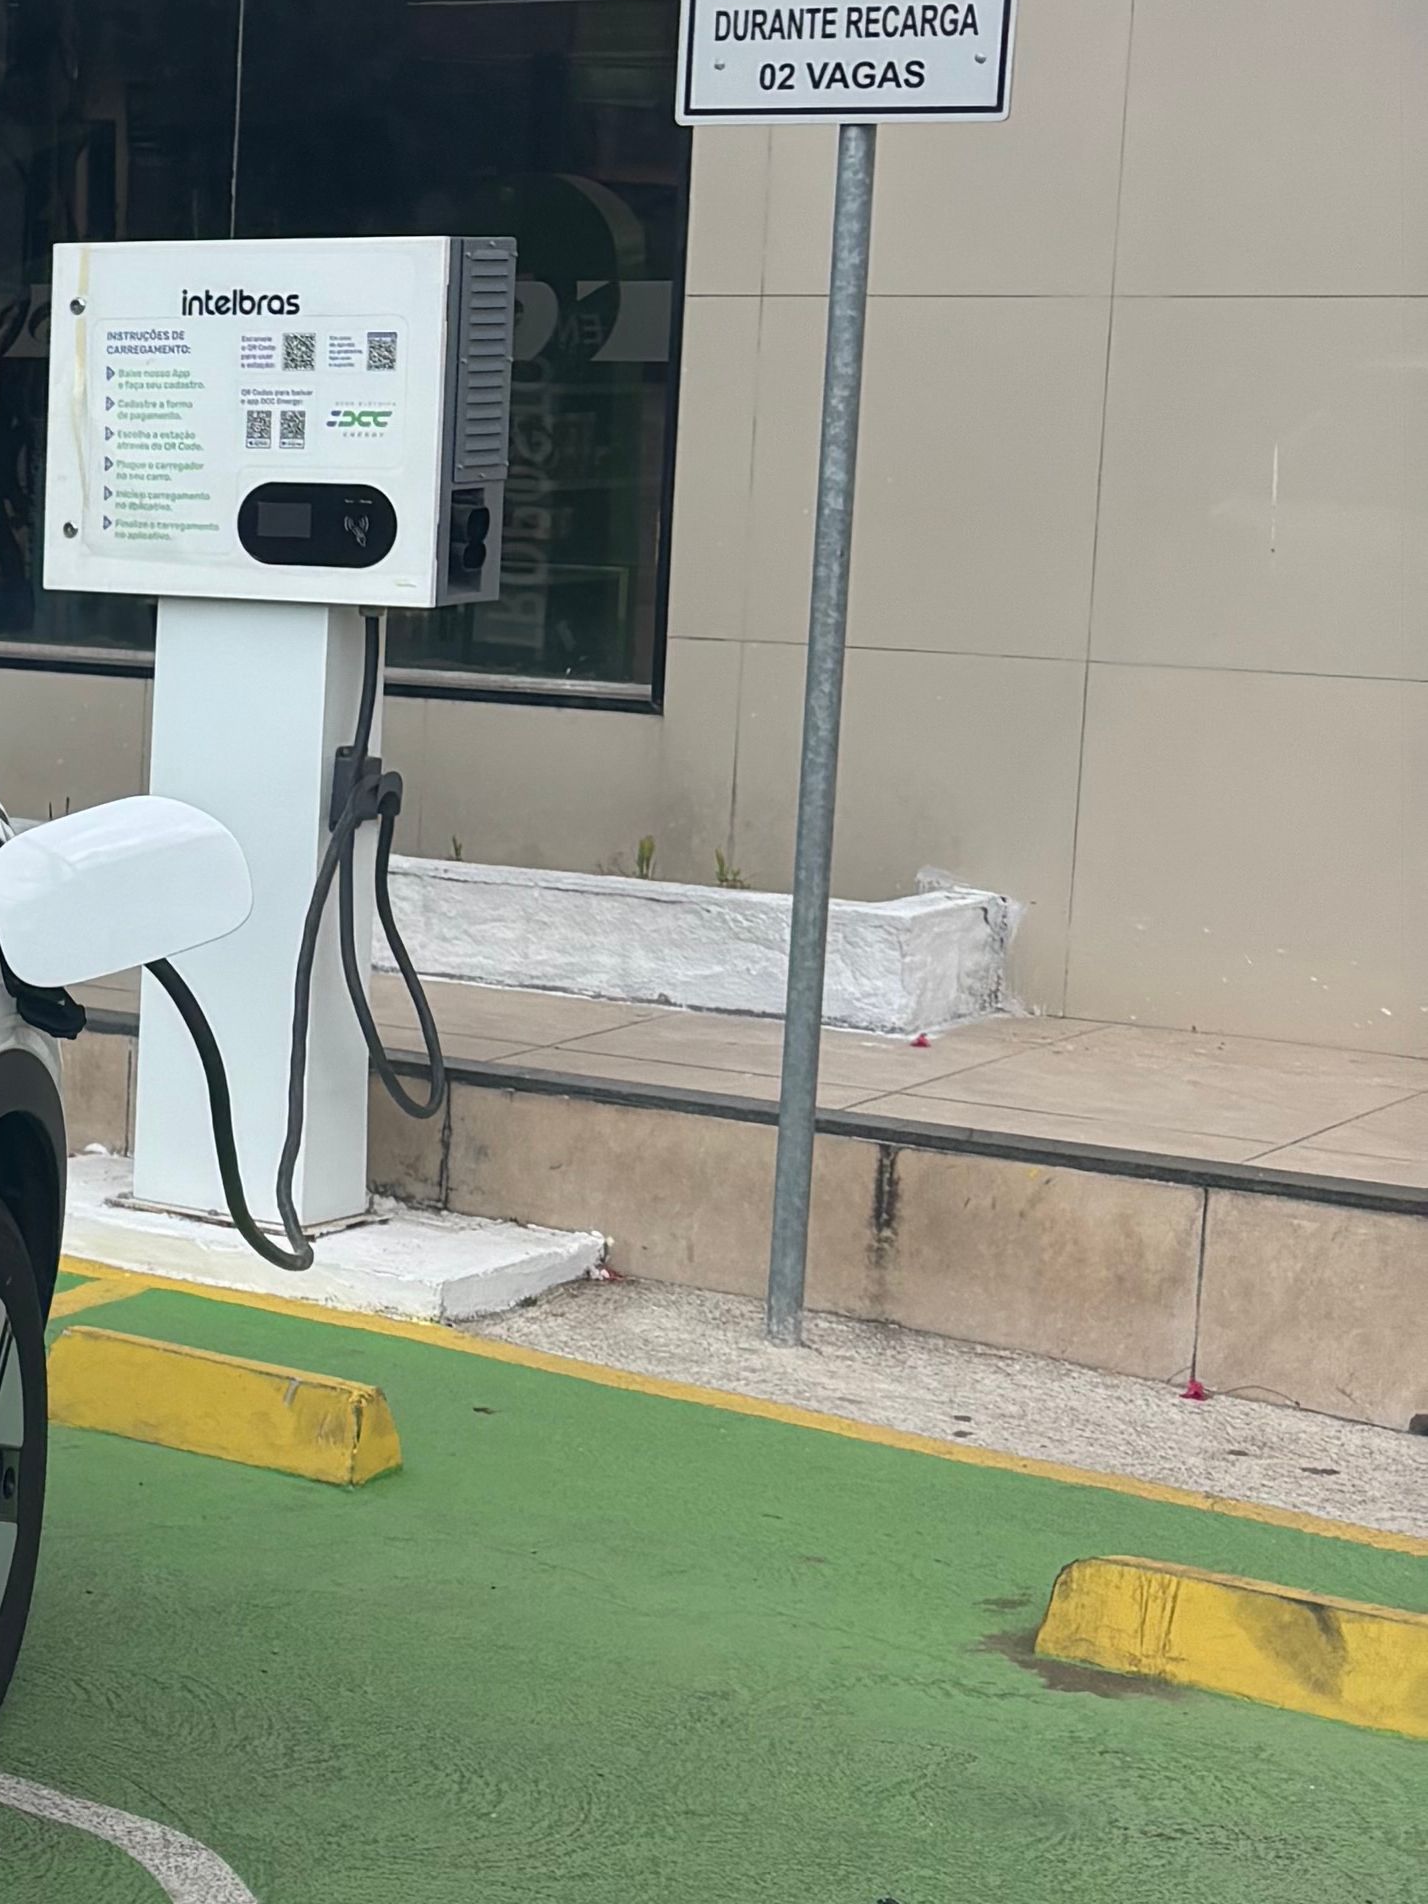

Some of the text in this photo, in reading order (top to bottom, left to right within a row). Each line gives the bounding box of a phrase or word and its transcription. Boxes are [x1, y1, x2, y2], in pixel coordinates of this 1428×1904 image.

[714, 3, 979, 42] DURANTE RECARGA
[759, 59, 927, 91] 02 VAGAS
[181, 288, 302, 316] intelbras
[106, 329, 185, 342] INSTRUÇÕES DE
[106, 344, 191, 355] CARREGAMENTO:
